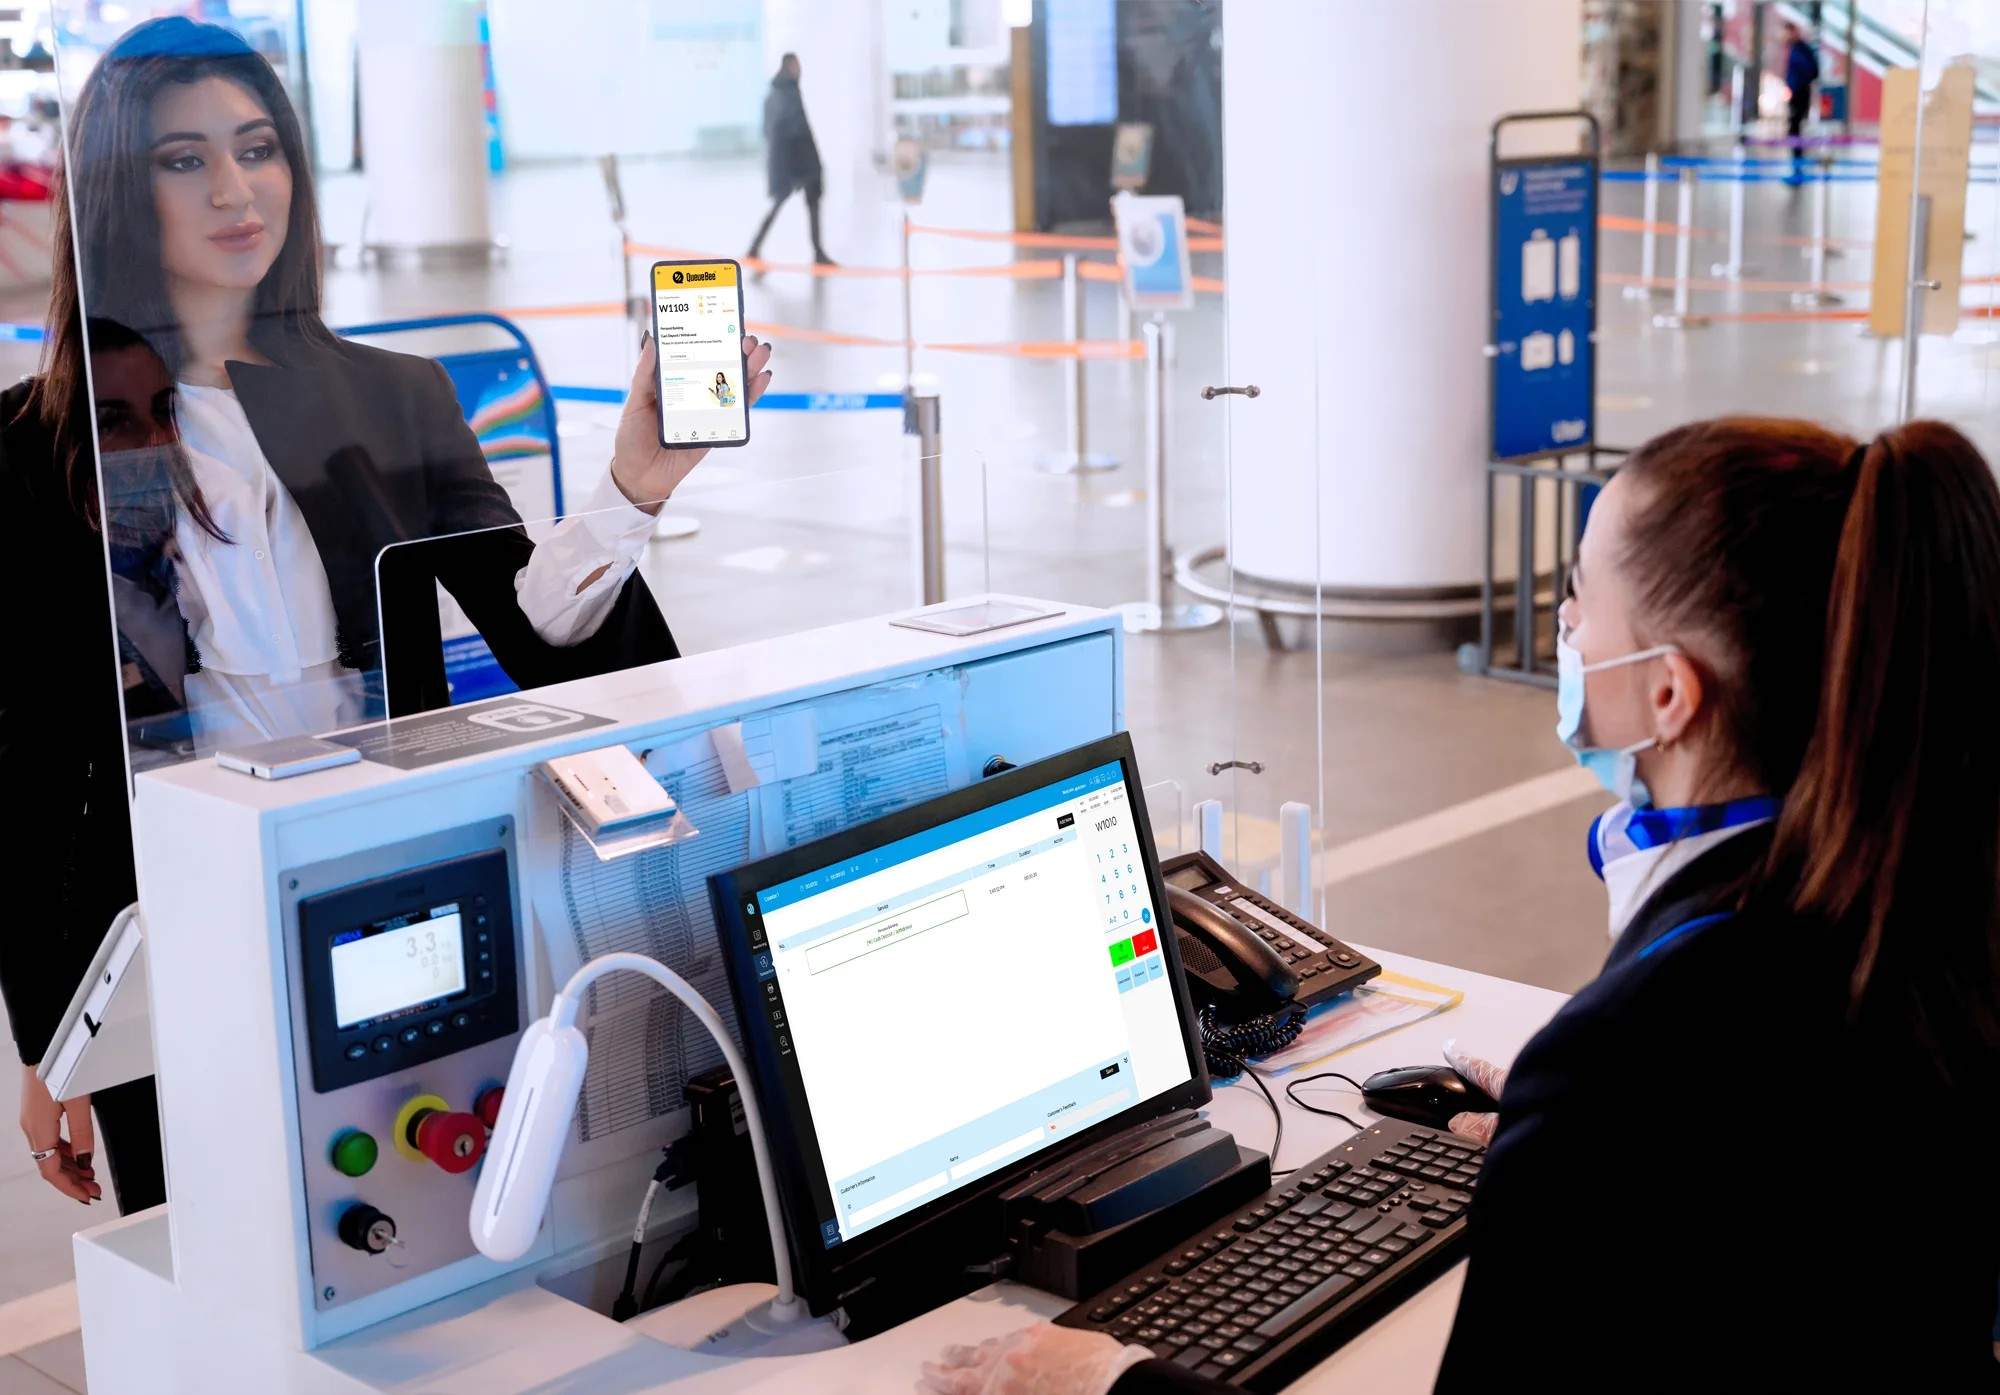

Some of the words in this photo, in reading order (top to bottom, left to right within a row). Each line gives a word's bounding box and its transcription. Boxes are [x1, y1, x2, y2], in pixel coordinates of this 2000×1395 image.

[686, 271, 716, 282] QueueBee
[658, 303, 690, 313] W1103
[1094, 815, 1118, 832] W1010
[1096, 853, 1101, 863] 1
[1109, 848, 1115, 859] 2
[1122, 843, 1128, 854] 3
[1101, 874, 1106, 883] 4
[1113, 869, 1120, 879] 5
[1127, 863, 1133, 874] 6
[1105, 894, 1111, 904] 7
[1118, 889, 1125, 899] 8
[1131, 884, 1137, 894] 9
[1123, 909, 1129, 919] 0
[406, 931, 437, 958] 3.3
